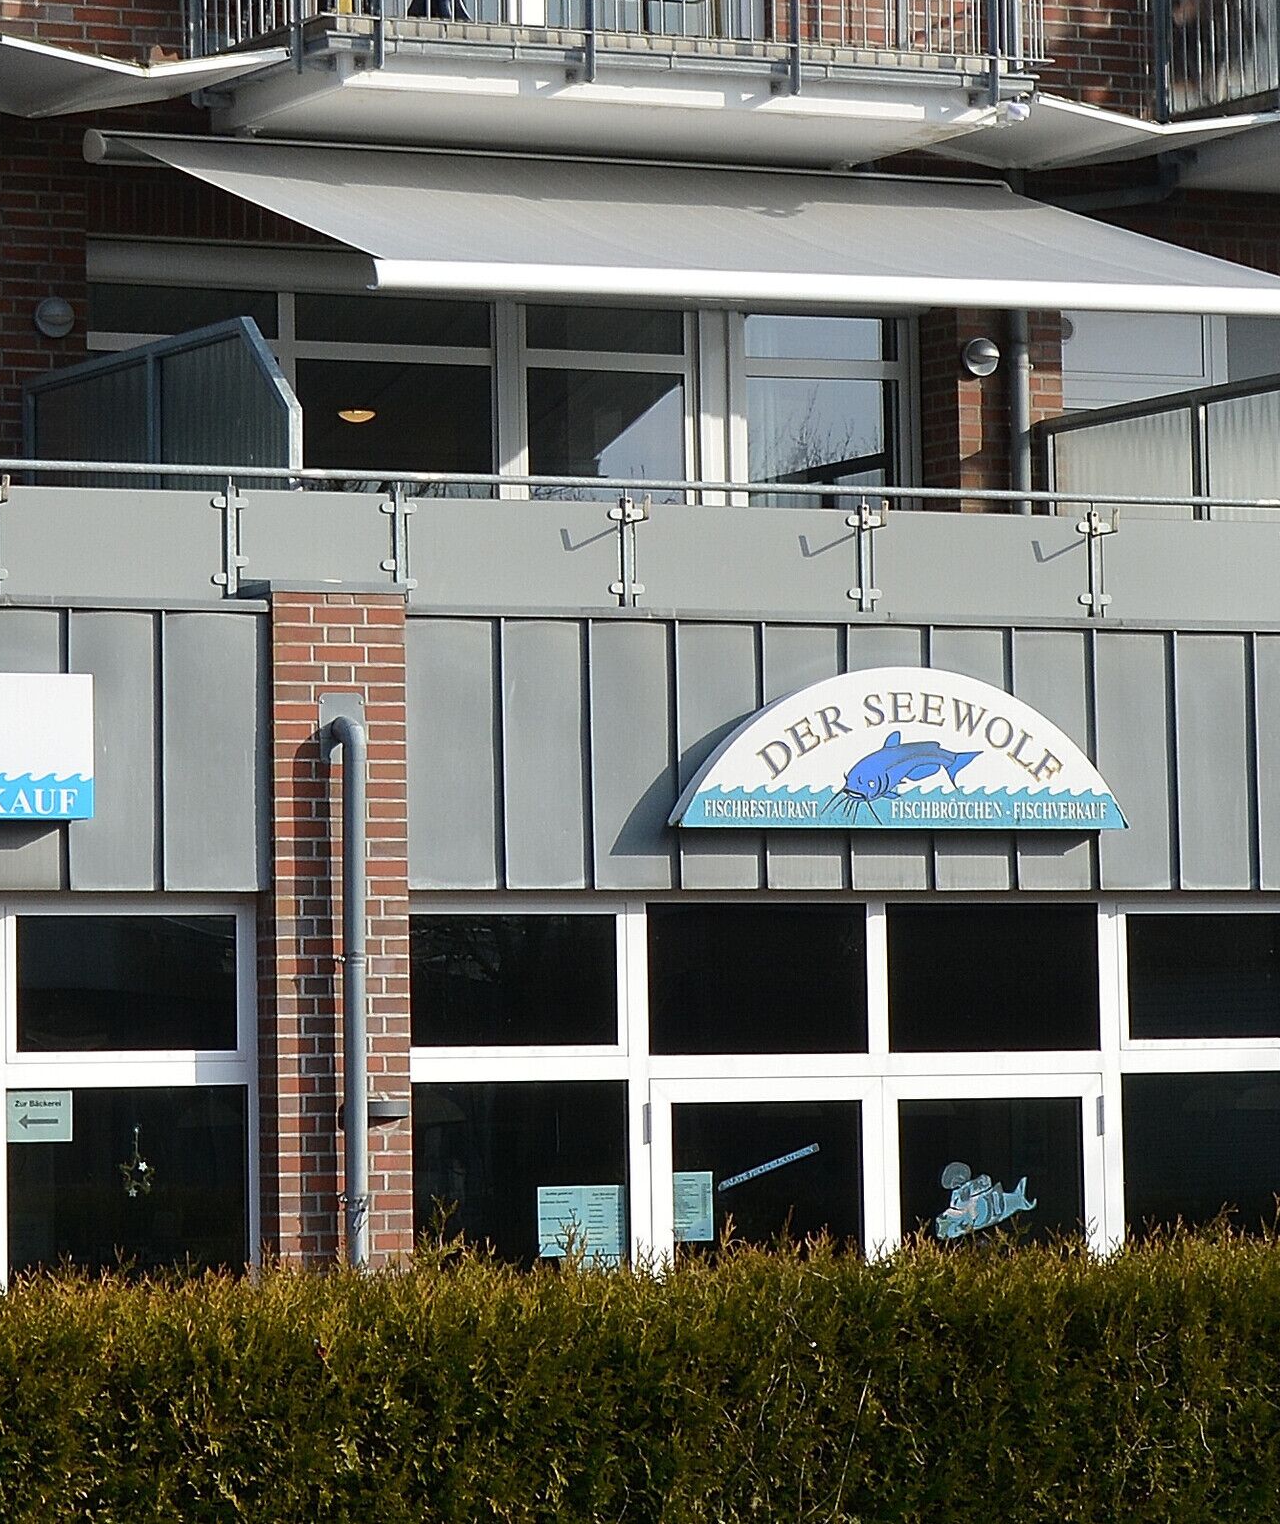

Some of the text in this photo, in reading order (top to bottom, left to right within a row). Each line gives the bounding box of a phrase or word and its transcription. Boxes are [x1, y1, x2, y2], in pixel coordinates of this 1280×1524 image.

[756, 692, 1064, 782] DER SEEWOLF
[704, 799, 819, 819] FISCHRESTAURANT
[891, 799, 1004, 819] FISCHBRÖTCHEN
[1013, 802, 1108, 819] FISCHVERKAUF
[29, 1099, 62, 1107] Bäckerei
